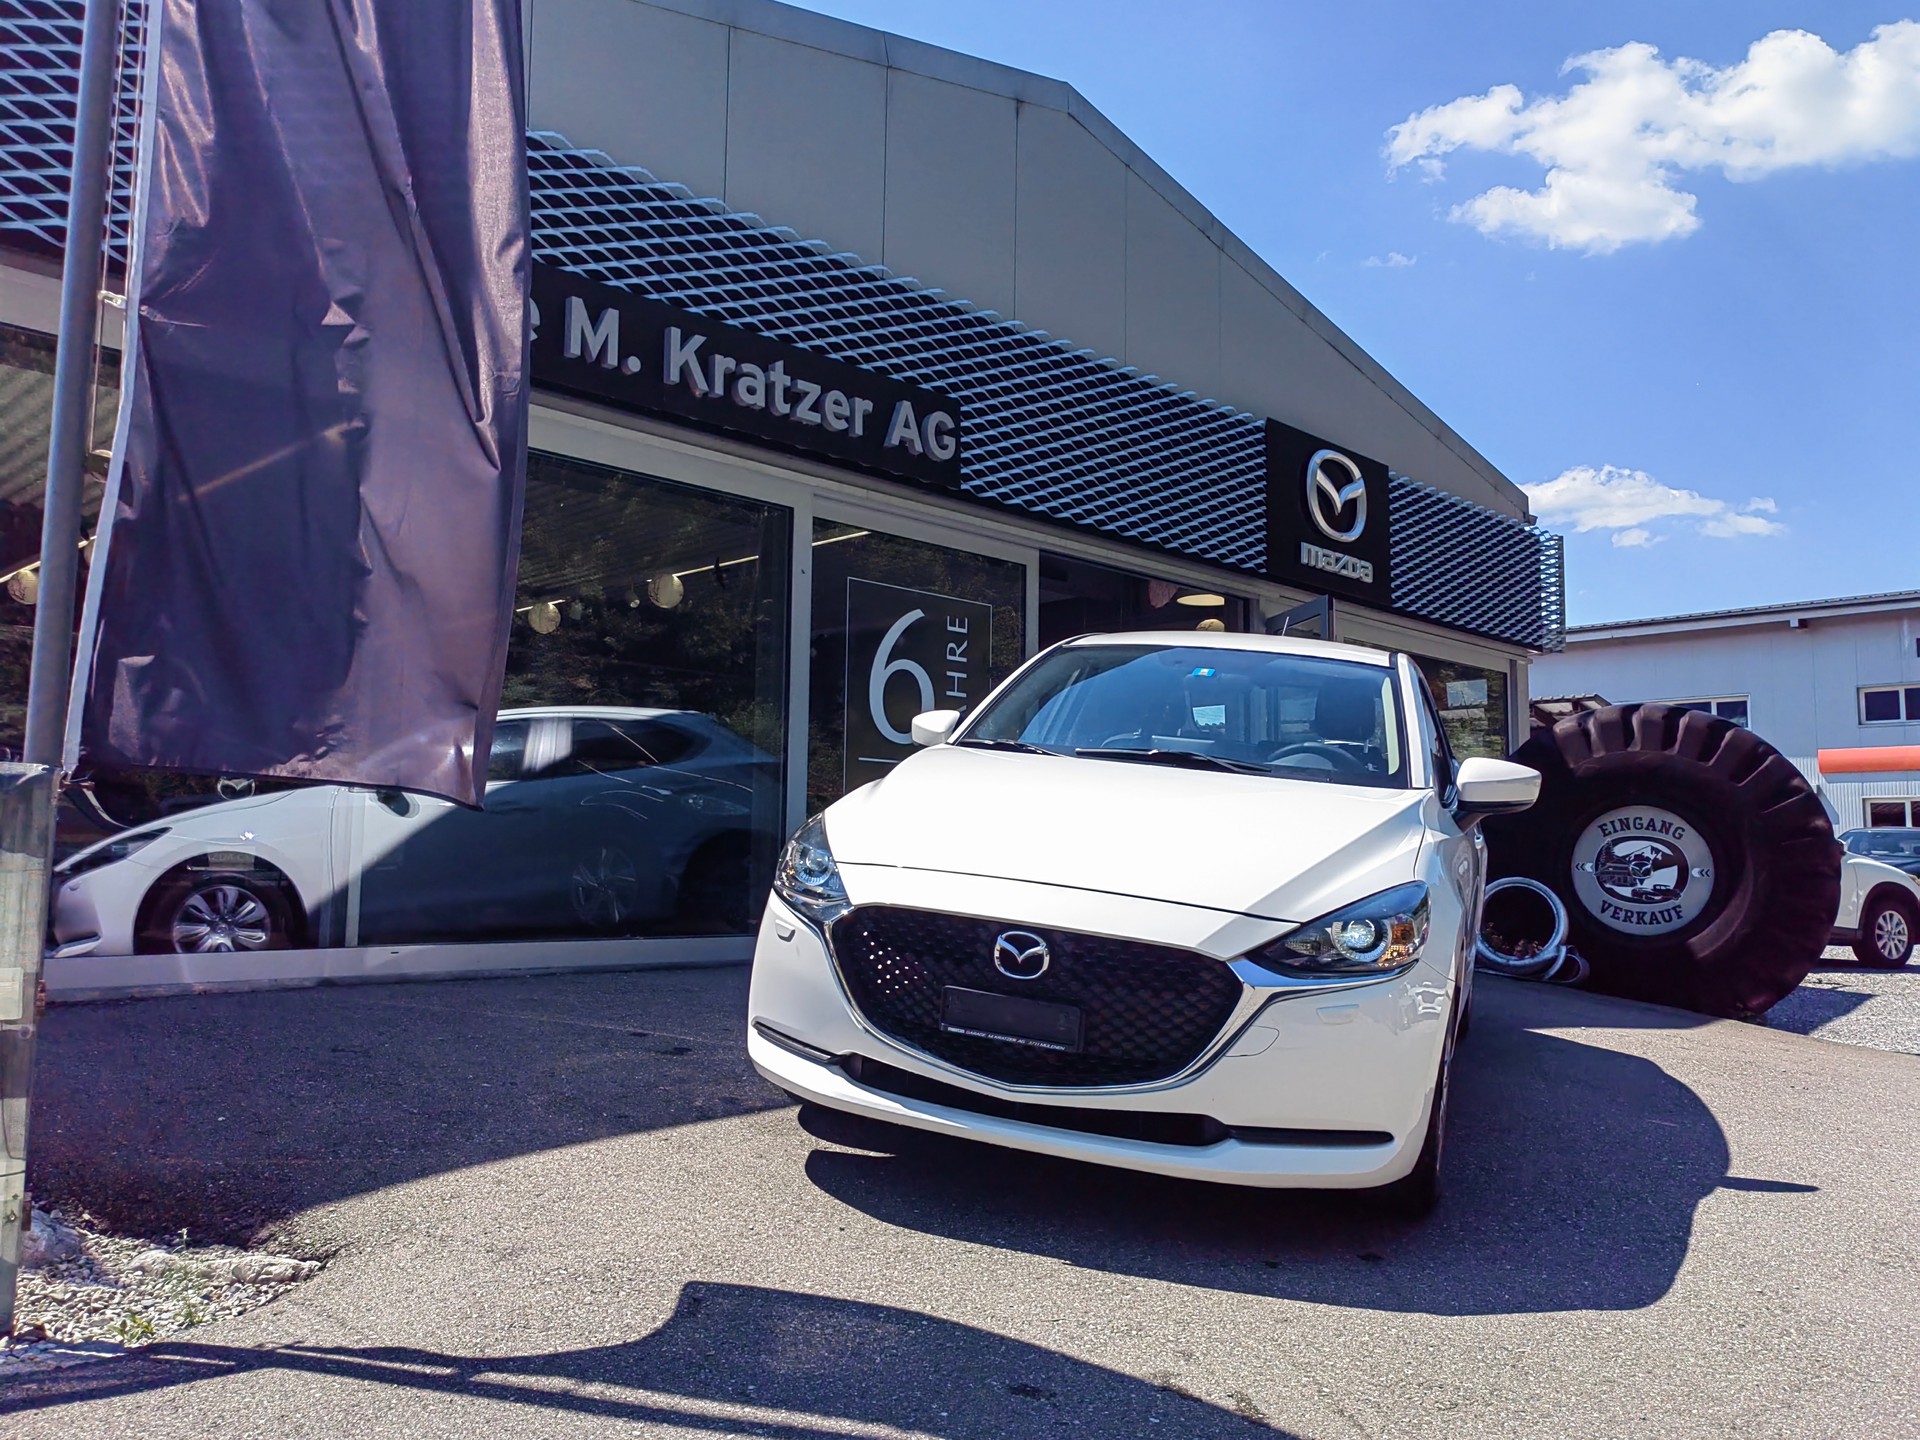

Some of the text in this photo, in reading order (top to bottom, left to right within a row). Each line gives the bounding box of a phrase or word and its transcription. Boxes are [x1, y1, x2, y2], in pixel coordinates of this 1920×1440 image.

[564, 296, 641, 375] M.
[664, 326, 873, 438] Kratzer
[883, 399, 956, 462] AG
[869, 608, 936, 746] 6
[1597, 816, 1686, 840] EINGANG
[1600, 899, 1684, 925] VERKAUF
